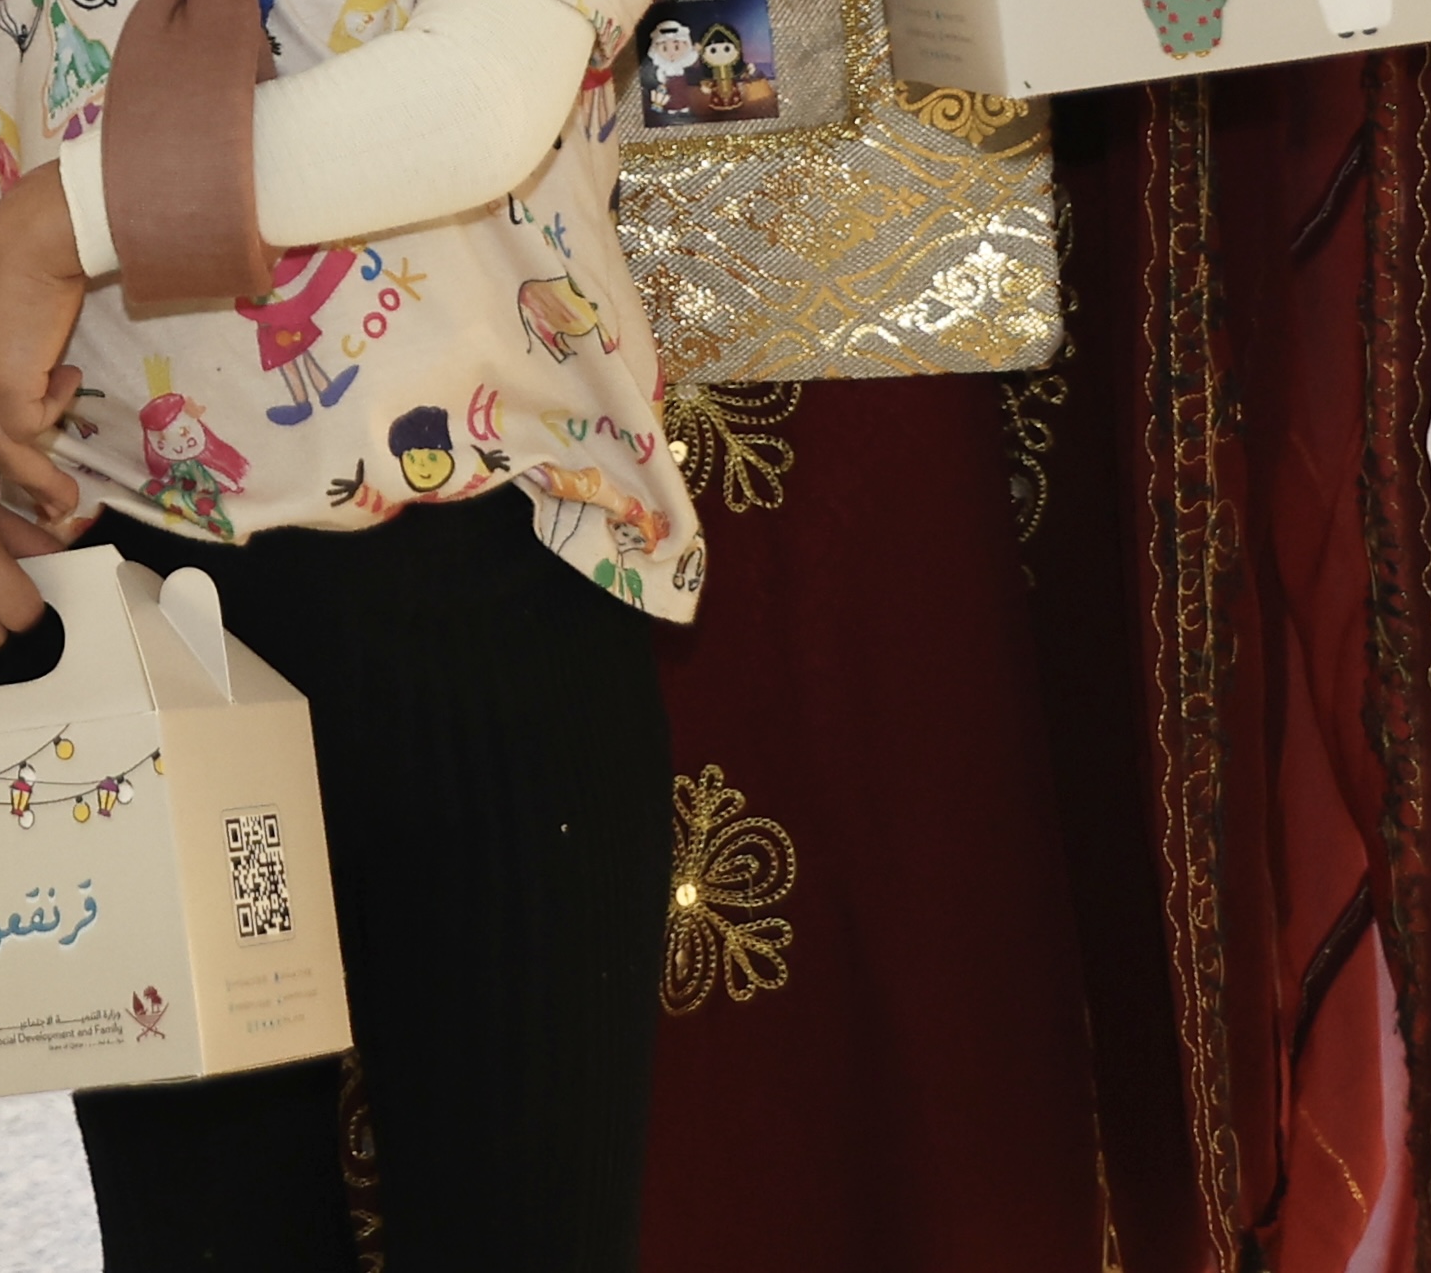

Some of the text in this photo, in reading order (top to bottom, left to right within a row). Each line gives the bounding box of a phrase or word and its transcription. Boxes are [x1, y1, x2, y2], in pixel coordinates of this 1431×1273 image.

[18, 1028, 75, 1043] Development
[77, 1026, 93, 1037] and
[94, 1021, 123, 1036] Family
